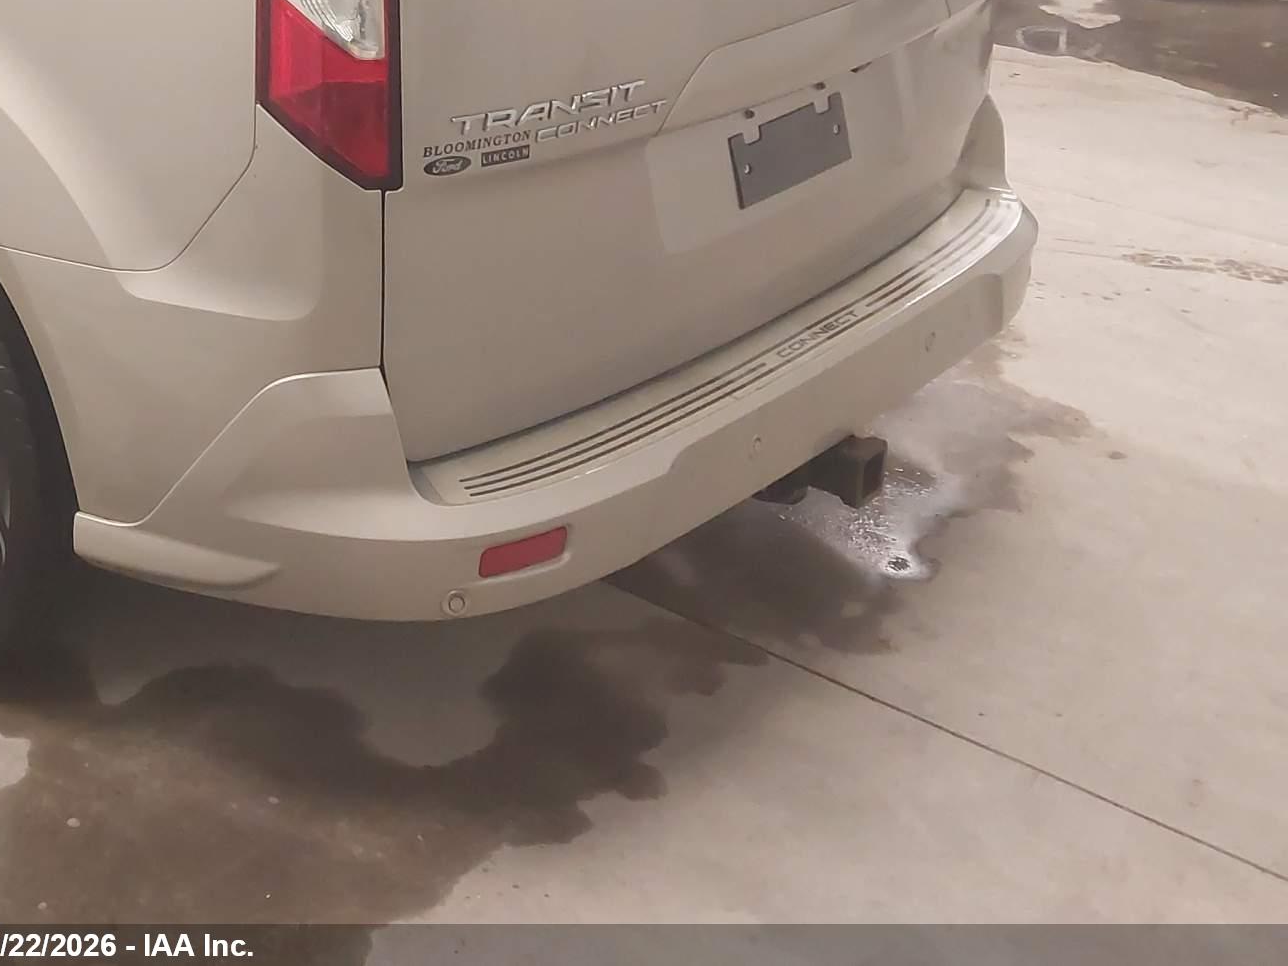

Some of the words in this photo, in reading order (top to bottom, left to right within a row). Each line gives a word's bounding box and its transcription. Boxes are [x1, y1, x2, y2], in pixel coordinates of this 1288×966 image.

[450, 79, 646, 134] TRANSIT
[534, 98, 667, 143] CONNECT
[422, 129, 532, 158] BLOOMINGTON
[482, 146, 530, 166] LINCOLN
[776, 310, 860, 358] CONNECT
